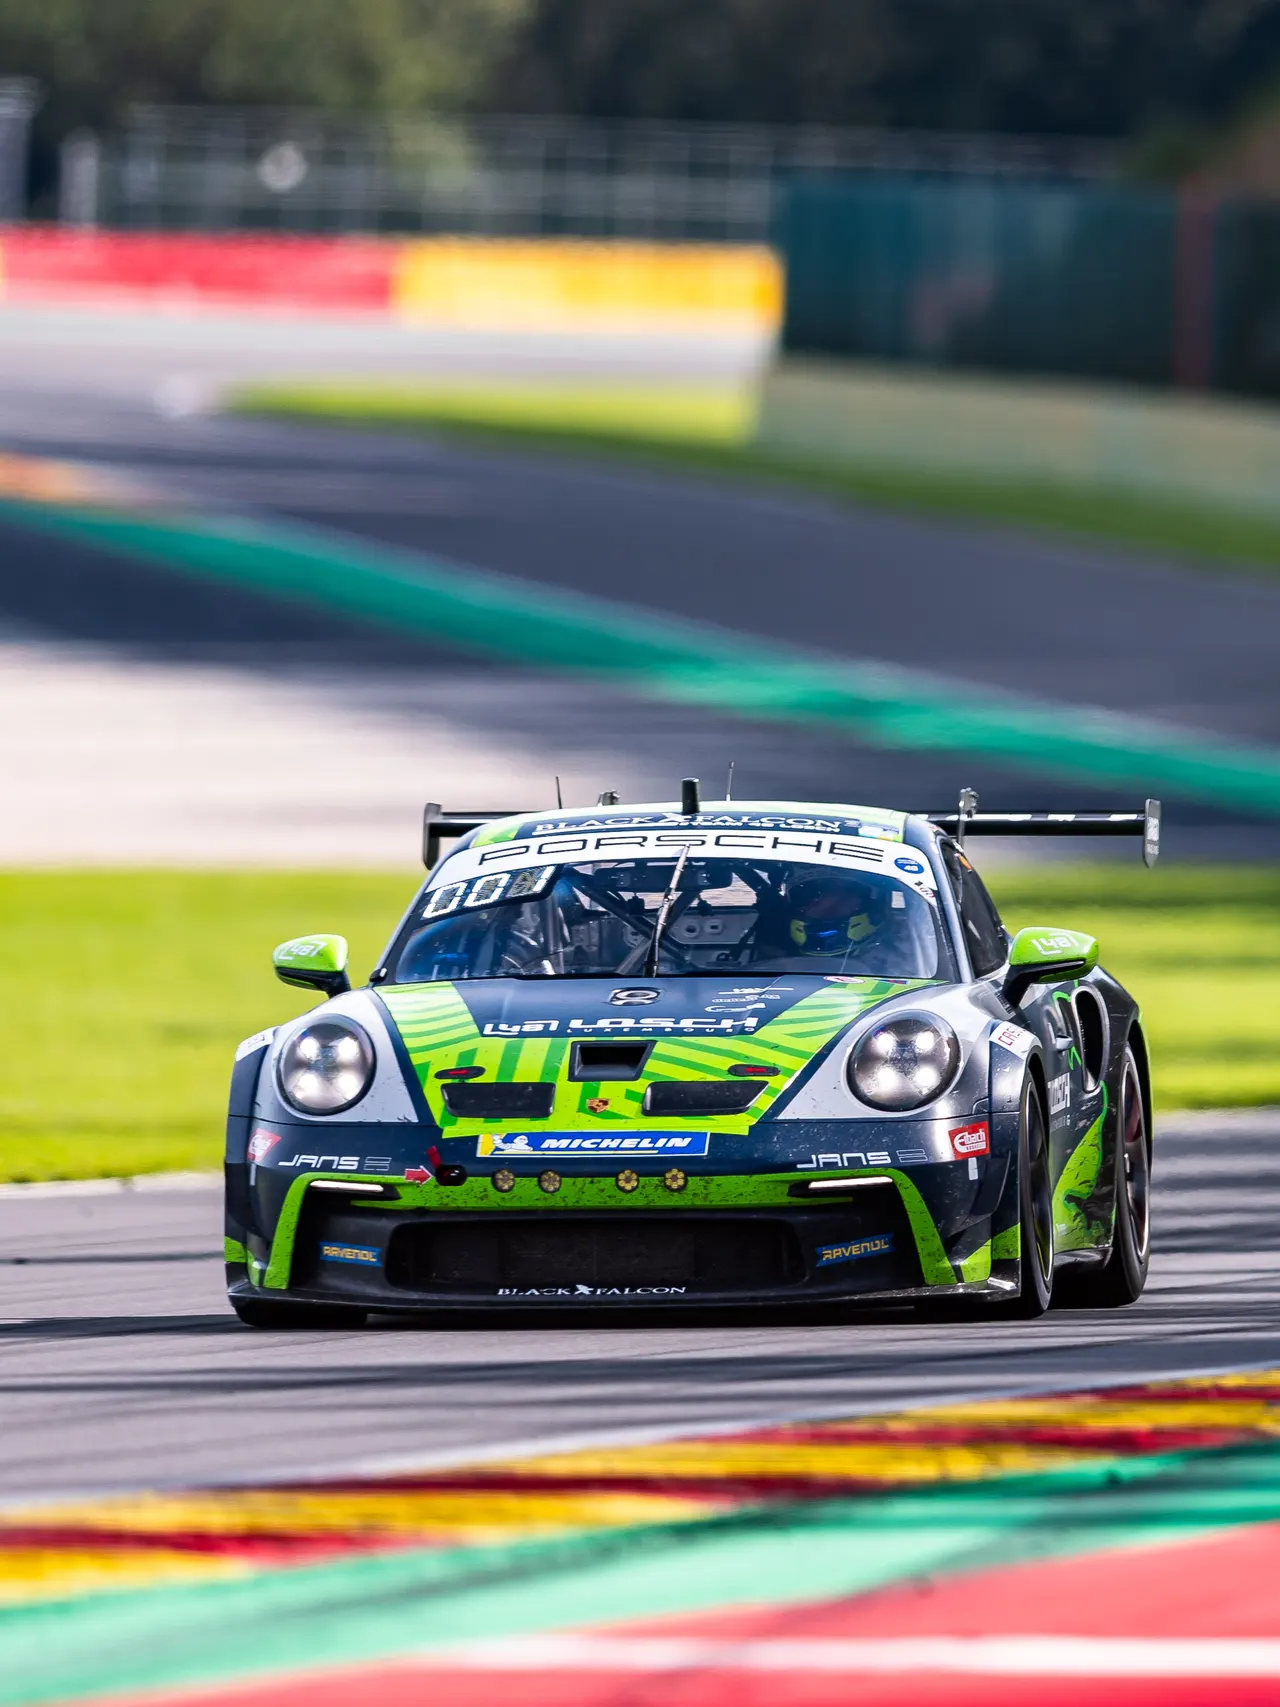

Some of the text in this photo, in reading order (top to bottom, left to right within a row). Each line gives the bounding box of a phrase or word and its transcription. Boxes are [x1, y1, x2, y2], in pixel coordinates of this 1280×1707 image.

[534, 816, 656, 832] BLACK
[695, 815, 842, 828] FALCON
[478, 833, 885, 866] PORSCHE
[568, 1017, 760, 1029] LOSCH
[540, 1137, 693, 1149] MICHELIN
[277, 1154, 361, 1170] JANS
[796, 1151, 892, 1168] JANS
[821, 1239, 889, 1260] RAVENOL
[596, 1286, 687, 1295] FALCON
